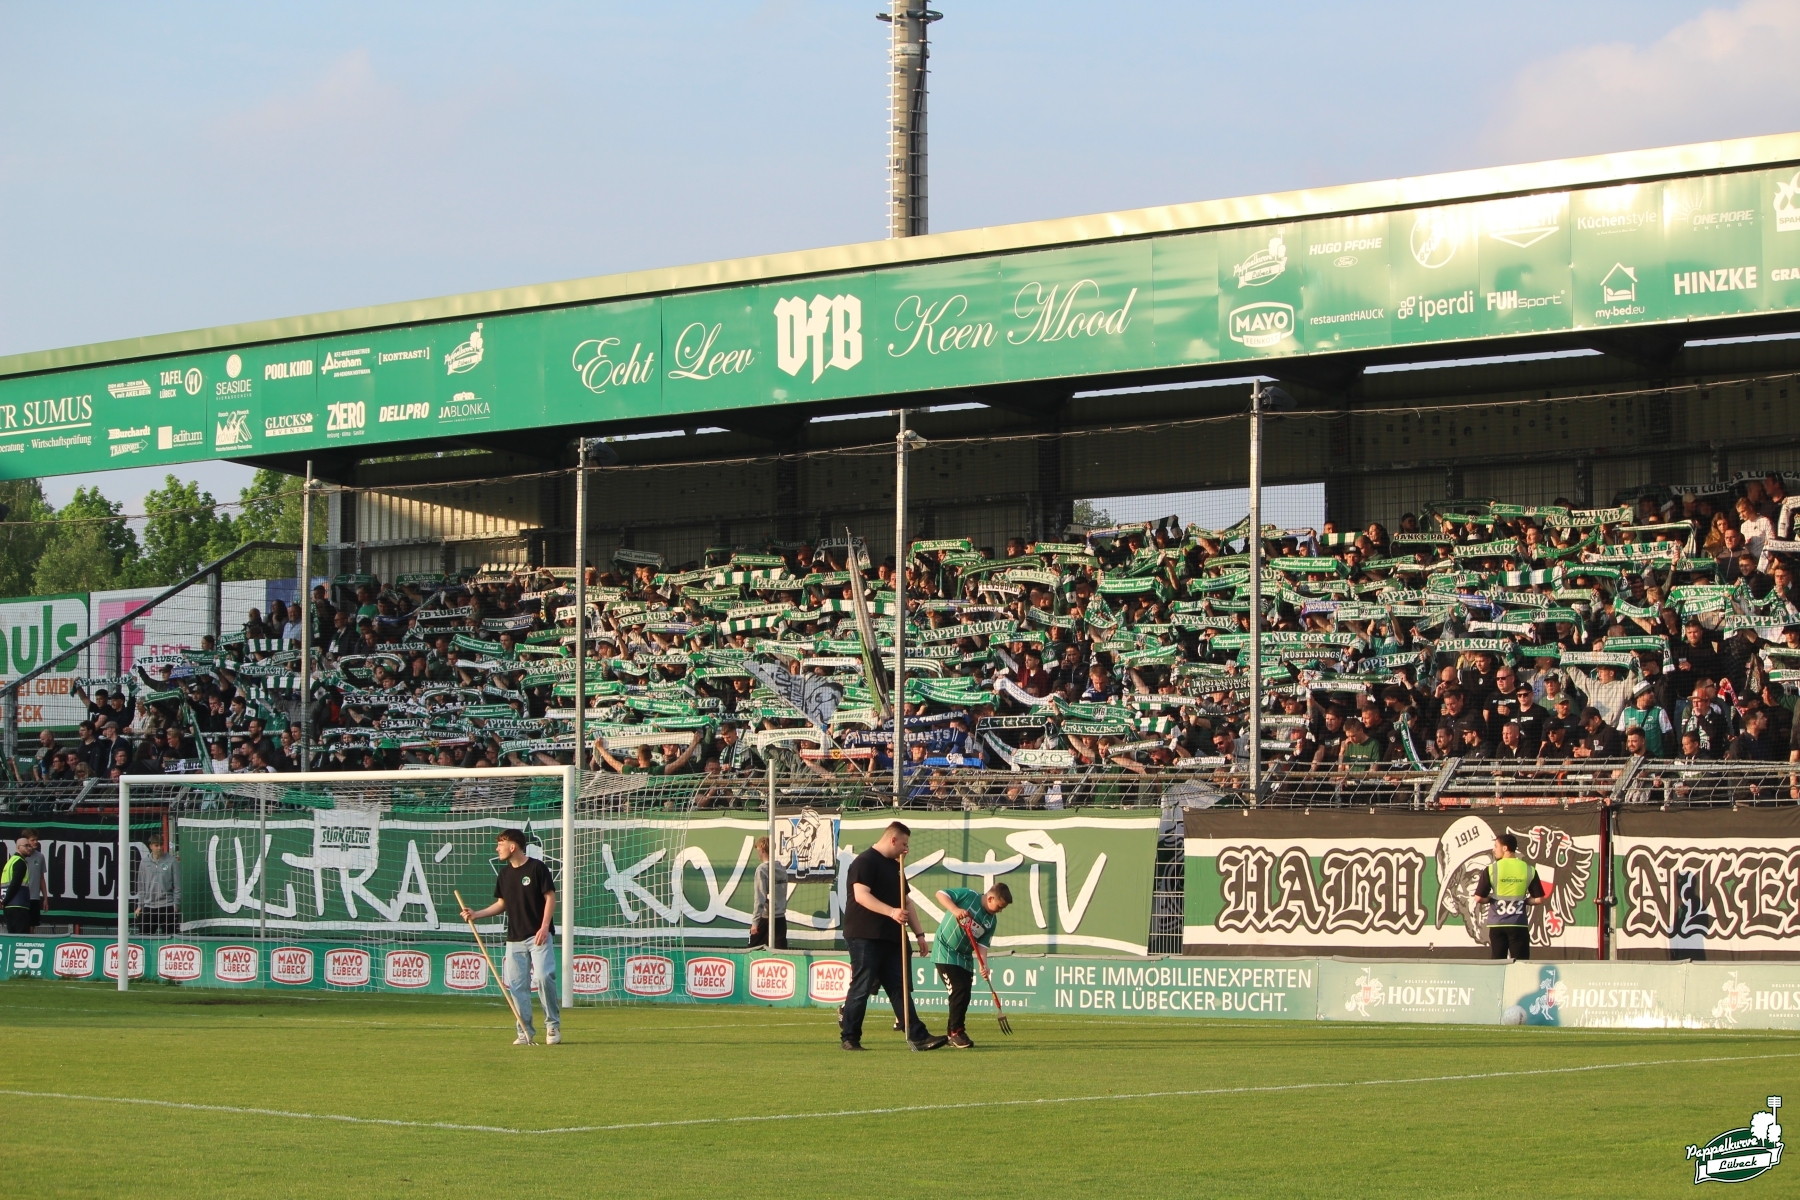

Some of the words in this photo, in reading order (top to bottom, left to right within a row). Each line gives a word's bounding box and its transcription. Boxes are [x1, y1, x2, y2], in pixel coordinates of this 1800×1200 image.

[1577, 210, 1657, 230] Küchenstyle
[1693, 213, 1719, 225] ONE
[1719, 210, 1754, 222] MORE
[1694, 221, 1753, 231] ENERGY
[1309, 243, 1342, 256] HUGO
[1344, 238, 1382, 251] PFOHE
[1674, 266, 1757, 295] HINZKE
[1419, 290, 1474, 323] iperdi
[1596, 304, 1645, 319] my-bed.eu
[887, 294, 998, 357] Keen
[1006, 279, 1138, 345] Mood
[1236, 311, 1288, 333] MAYO
[1310, 308, 1384, 325] restaurantHAUCK
[1246, 335, 1278, 345] FEINKOST
[321, 352, 362, 375] Abraham
[571, 336, 654, 393] Echt
[667, 322, 754, 380] Leev
[160, 370, 182, 386] TAFEL
[160, 388, 176, 399] LÜBECK
[216, 379, 252, 395] SEASIDE
[23, 395, 92, 427] SUMUS
[379, 402, 430, 422] DELLPRO
[438, 402, 490, 418] JABLONKA
[265, 414, 306, 429] GLÜCKS
[31, 434, 92, 449] Wirtschaftsprüfung
[173, 430, 203, 442] aditum
[1378, 591, 1430, 604] PAPPELK
[529, 662, 597, 675] PAPPELKUVE
[1454, 826, 1480, 848] 1919
[1496, 900, 1524, 915] 362
[13, 948, 44, 969] 30
[61, 949, 89, 960] MAYO
[111, 949, 138, 960] MYO
[165, 951, 195, 961] MAYO
[223, 952, 252, 963] MAYO
[278, 953, 307, 965] MAYO
[332, 955, 363, 966] MAYO
[392, 956, 424, 968] MAYO
[110, 960, 138, 969] LÜCK
[452, 957, 481, 970] MAYO
[633, 962, 666, 975] MAYO
[694, 964, 727, 977] MAYO
[757, 966, 788, 978] MAYO
[816, 967, 845, 980] MAYO
[1055, 966, 1098, 985] IHRE
[1102, 967, 1312, 989] IMMOBILIENEXPERTEN
[870, 994, 890, 1004] Fine
[914, 997, 949, 1006] opertie
[1055, 990, 1076, 1008] IN
[1084, 990, 1117, 1009] DER
[1122, 988, 1217, 1011] LÜBECKER
[1222, 992, 1288, 1013] BUCHT.
[1387, 986, 1472, 1006] HOLSTEN
[1572, 989, 1655, 1008] HOLSTEN
